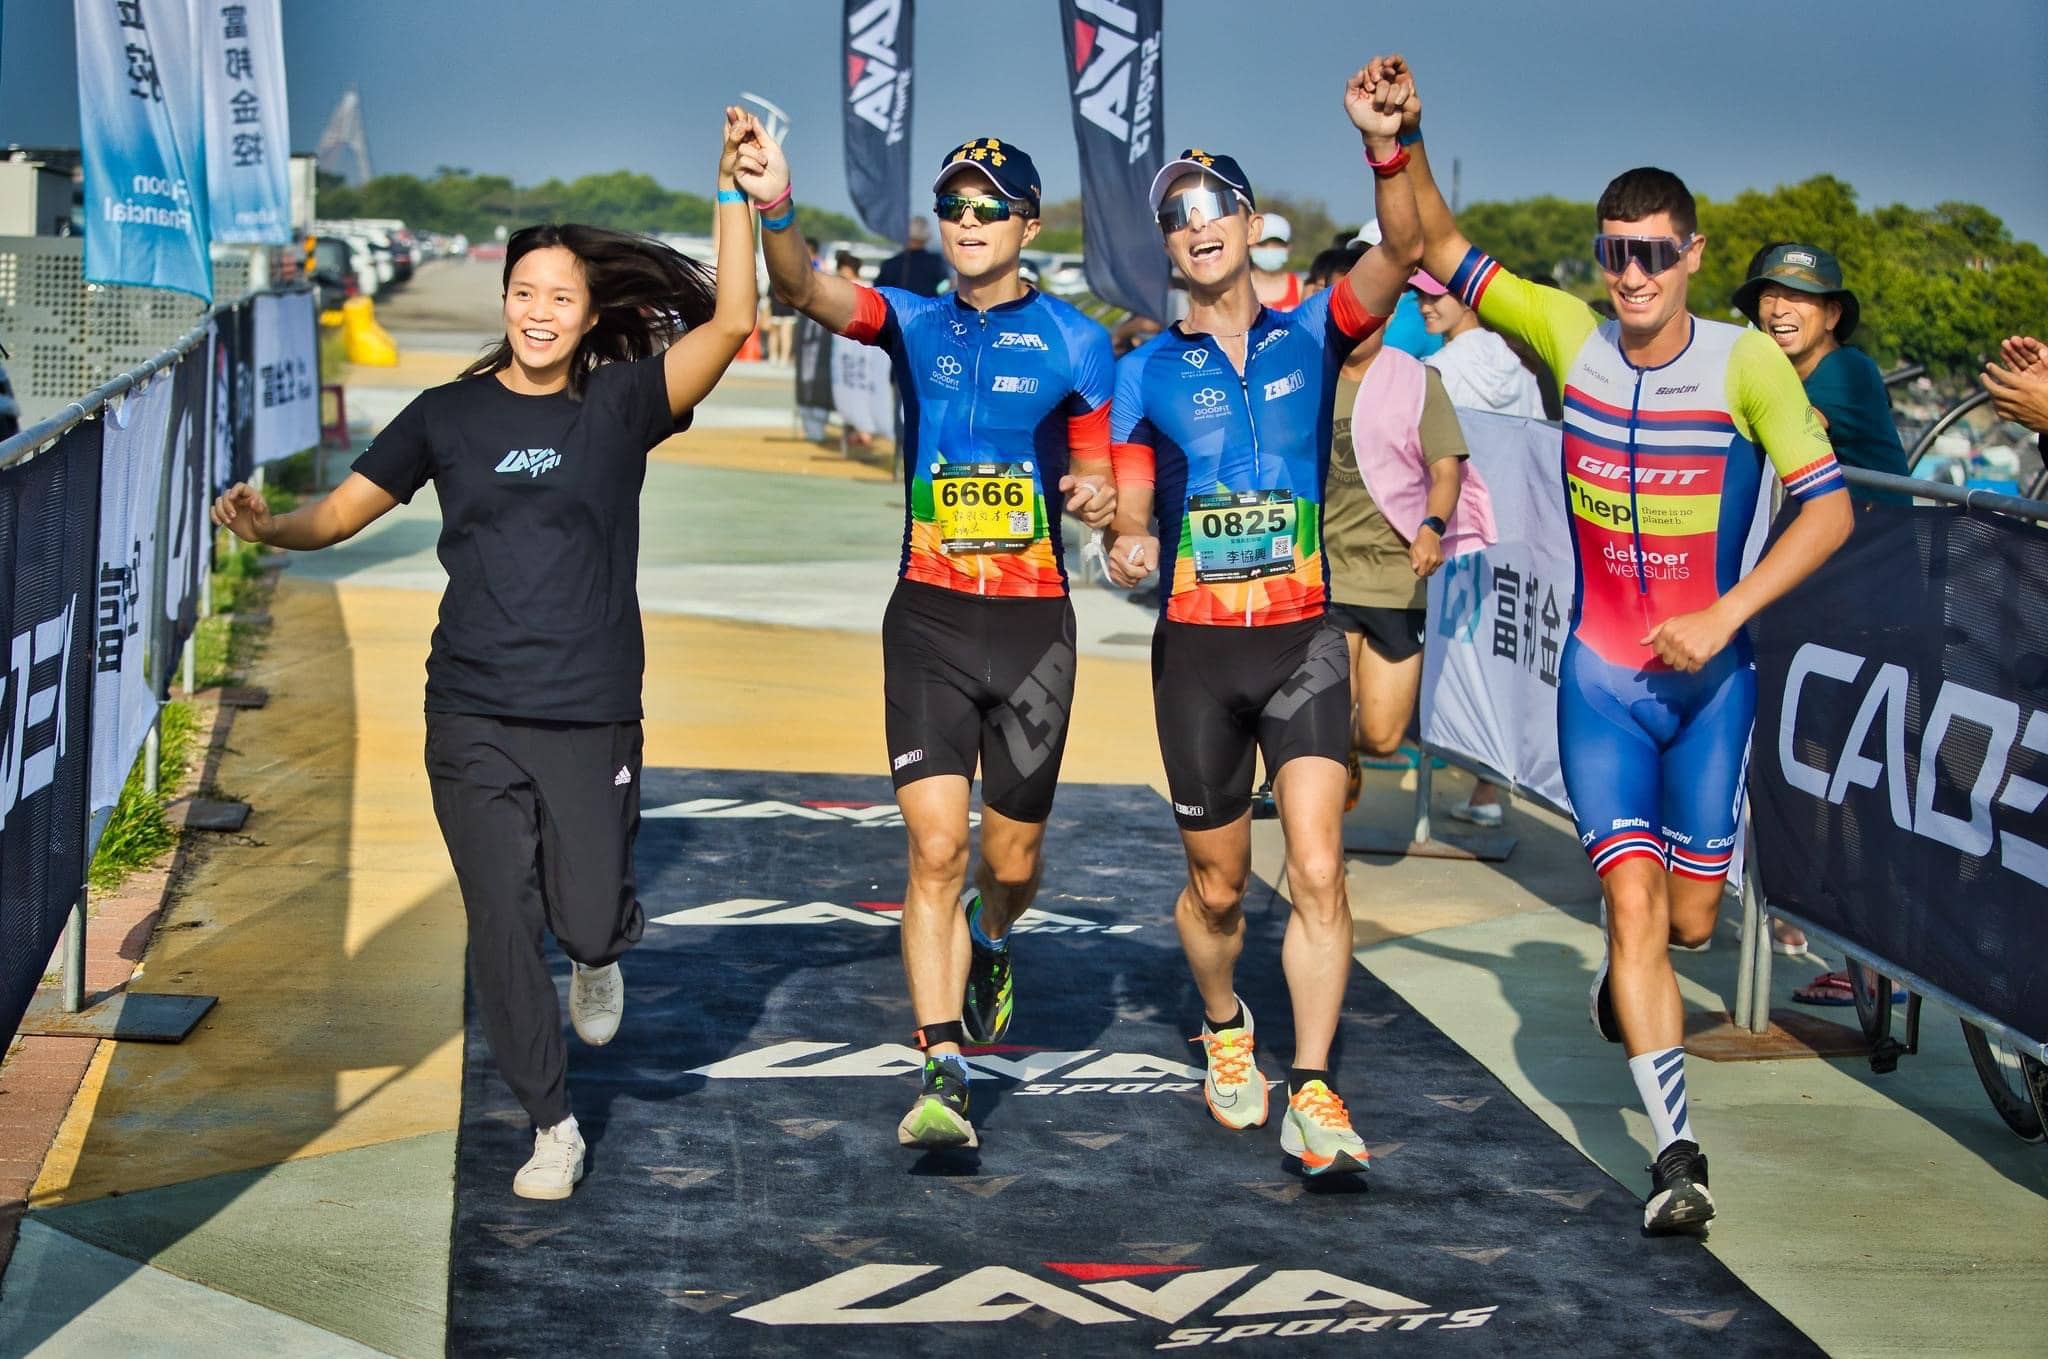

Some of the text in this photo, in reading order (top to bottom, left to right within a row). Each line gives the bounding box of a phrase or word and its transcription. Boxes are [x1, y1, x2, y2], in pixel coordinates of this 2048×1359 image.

[1655, 384, 1699, 395] Santini
[1577, 455, 1711, 486] GIANT
[942, 481, 1024, 507] 6666
[1580, 486, 1632, 525] hep
[1202, 508, 1287, 539] 0825
[1641, 506, 1667, 516] there
[1602, 541, 1689, 565] deboer
[1605, 562, 1690, 580] wetsuits
[1492, 563, 1575, 688] 富邦金
[1612, 817, 1650, 830] Santini
[730, 1263, 1432, 1325] LAVA
[1155, 1305, 1499, 1351] SPORTS
